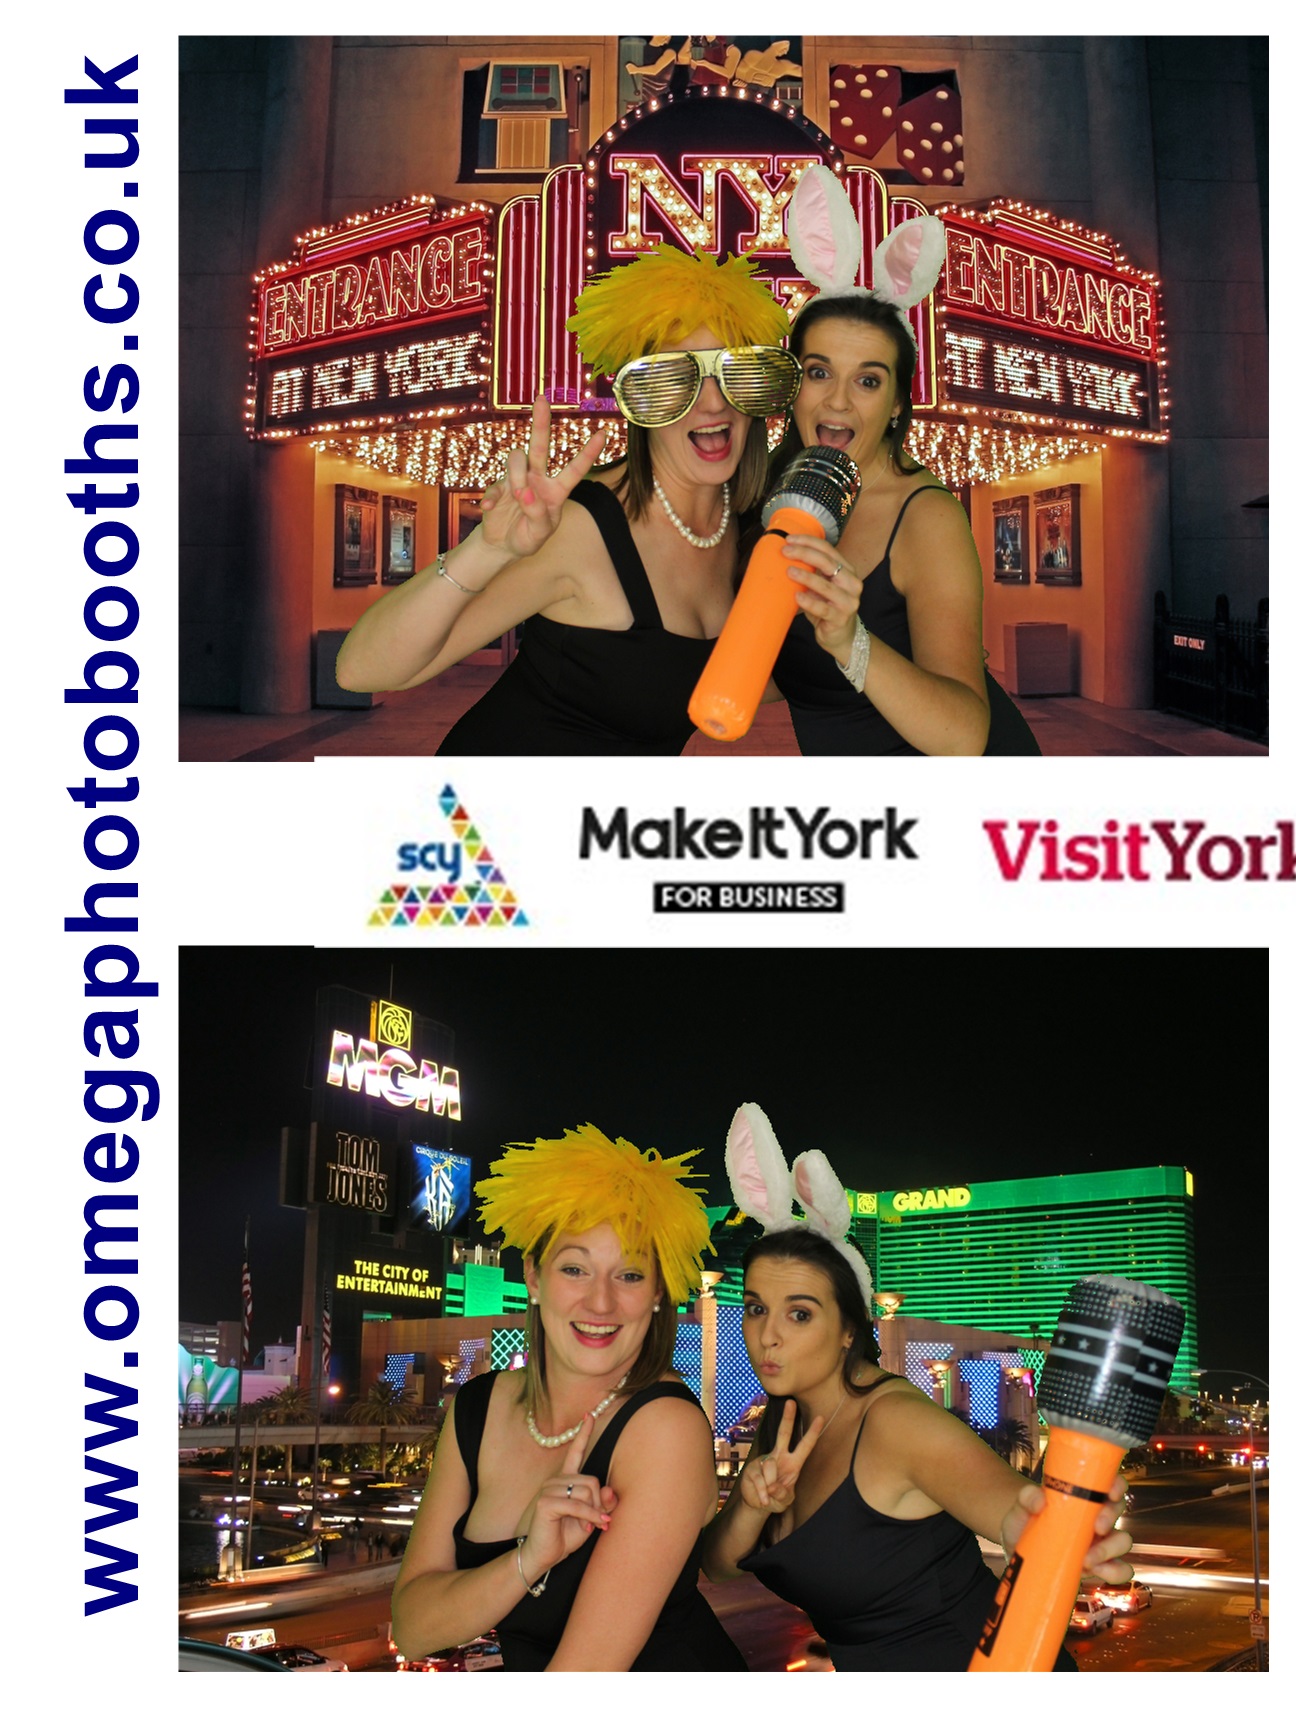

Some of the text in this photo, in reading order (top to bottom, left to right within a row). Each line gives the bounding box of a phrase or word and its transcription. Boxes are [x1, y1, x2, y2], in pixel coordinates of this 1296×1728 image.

[264, 228, 482, 347] ENTRANCE
[944, 227, 1152, 350] ENTRANCE
[271, 331, 481, 415] AT NEW YORK
[993, 343, 1063, 404] NEW
[1066, 357, 1143, 418] YORK
[1174, 635, 1205, 650] EXIT ONLY
[327, 1030, 462, 1121] MGM
[336, 1131, 380, 1173] TOM
[415, 1146, 438, 1159] CIRQUE
[449, 1154, 468, 1165] SOLEIL
[327, 1168, 388, 1213] JONES
[893, 1187, 971, 1212] GRAND
[337, 1274, 442, 1300] ENTERTAINMENT
[354, 1260, 429, 1283] THE CITY OF
